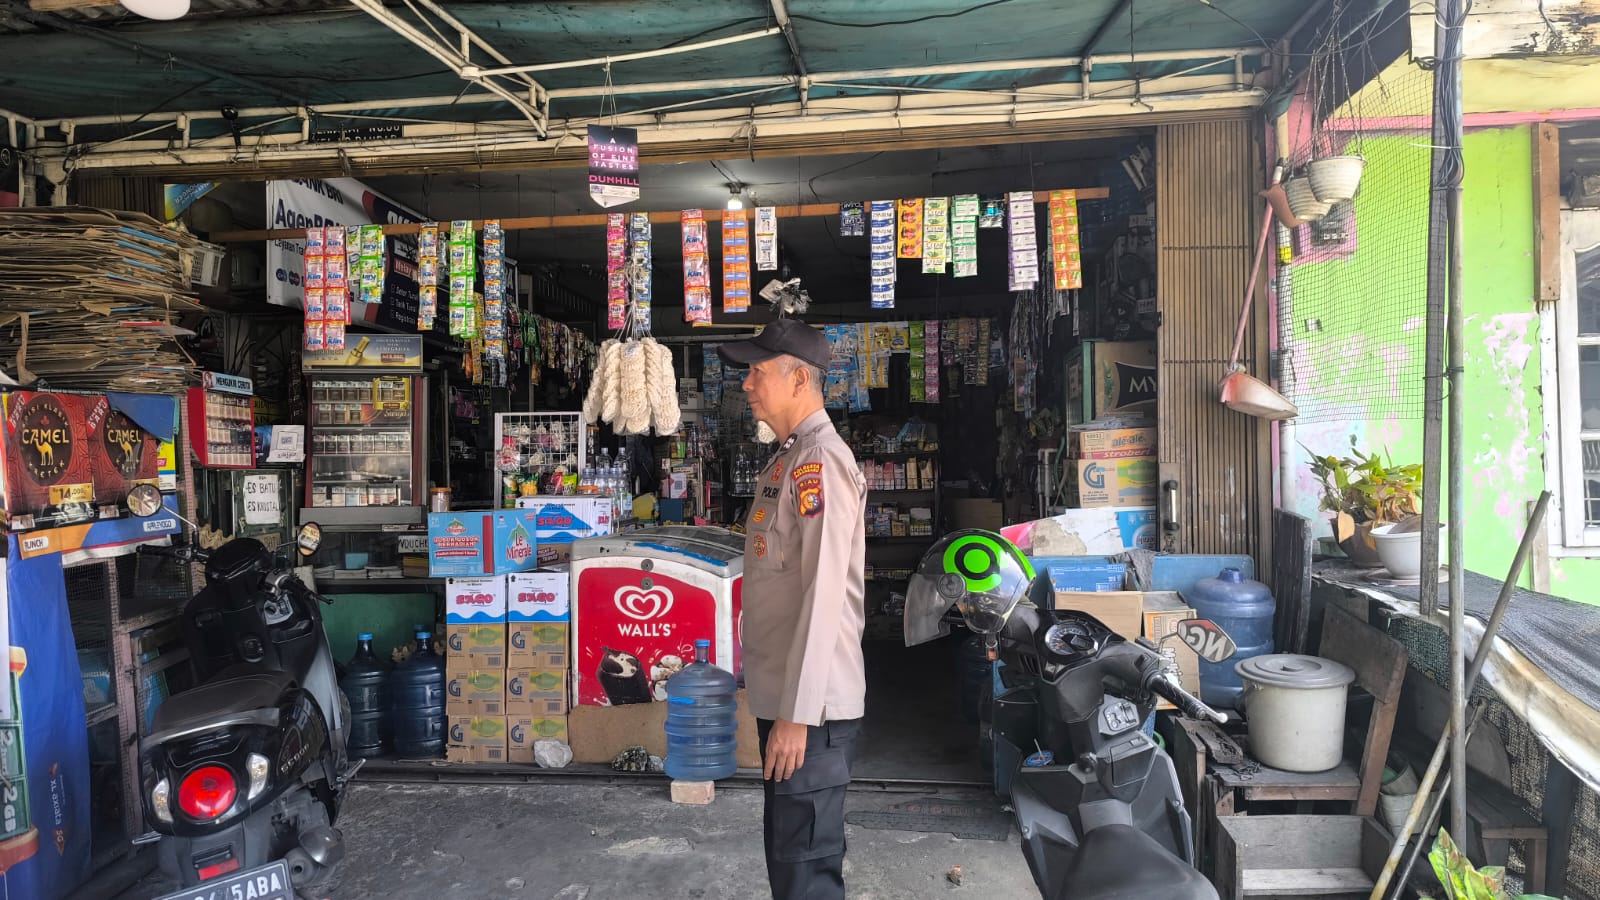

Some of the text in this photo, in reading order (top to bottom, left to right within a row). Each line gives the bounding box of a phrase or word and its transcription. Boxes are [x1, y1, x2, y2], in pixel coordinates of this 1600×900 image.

[593, 144, 633, 154] FUSION
[594, 161, 634, 170] TASTES
[588, 174, 640, 186] DUNHILL
[22, 429, 70, 444] CAMEL
[108, 429, 142, 444] CAMEL
[260, 482, 276, 494] BATU
[799, 479, 818, 488] RIAU
[762, 486, 780, 499] POLRI
[515, 531, 522, 546] Le
[506, 544, 532, 560] Minerale
[617, 623, 672, 637] WALL'S
